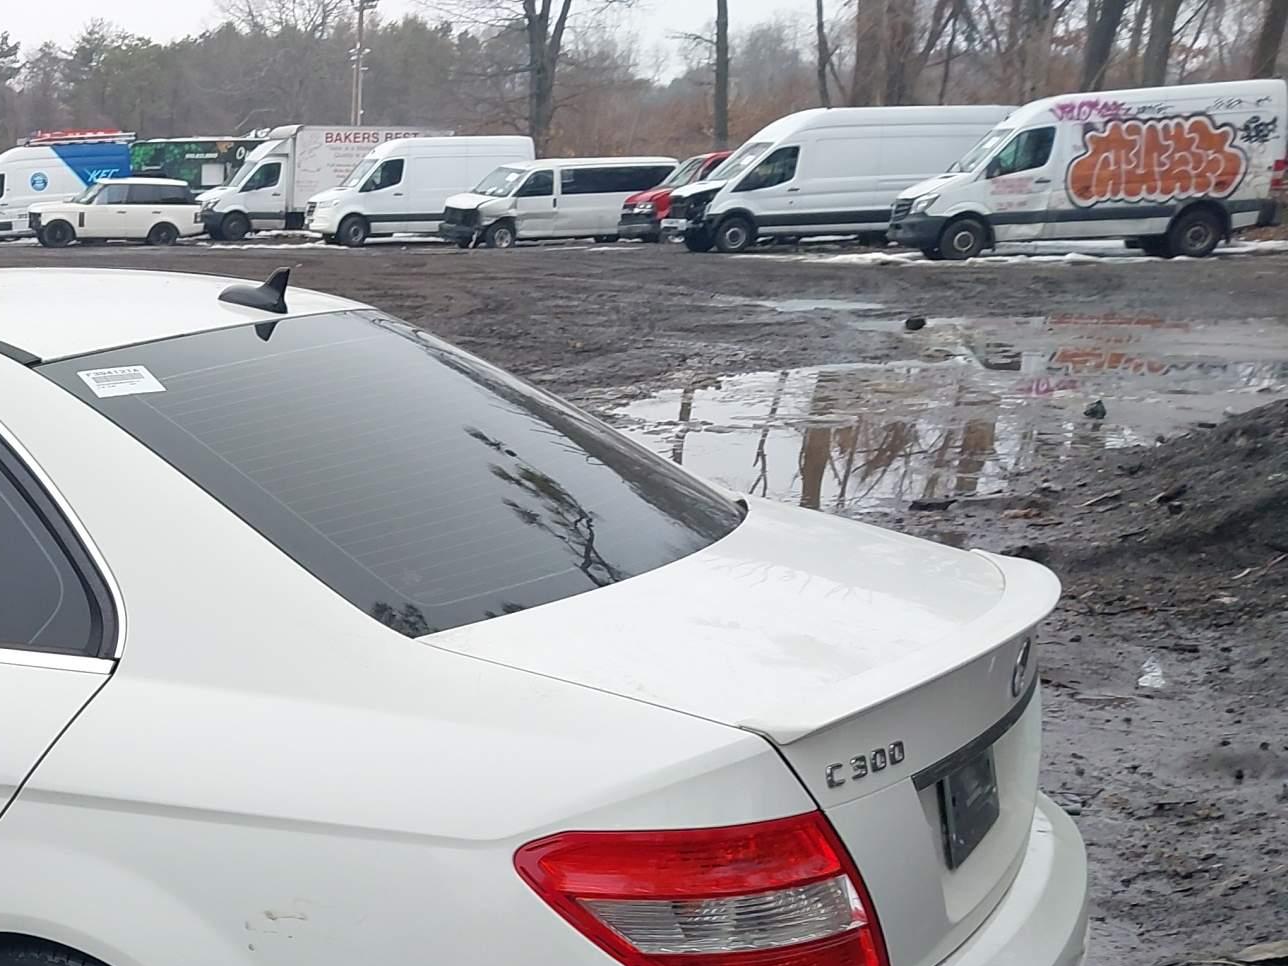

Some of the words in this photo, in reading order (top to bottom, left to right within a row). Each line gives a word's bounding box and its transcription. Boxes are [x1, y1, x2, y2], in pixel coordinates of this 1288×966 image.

[324, 132, 380, 144] BAKERS
[825, 762, 846, 788] C
[849, 740, 905, 780] 300
